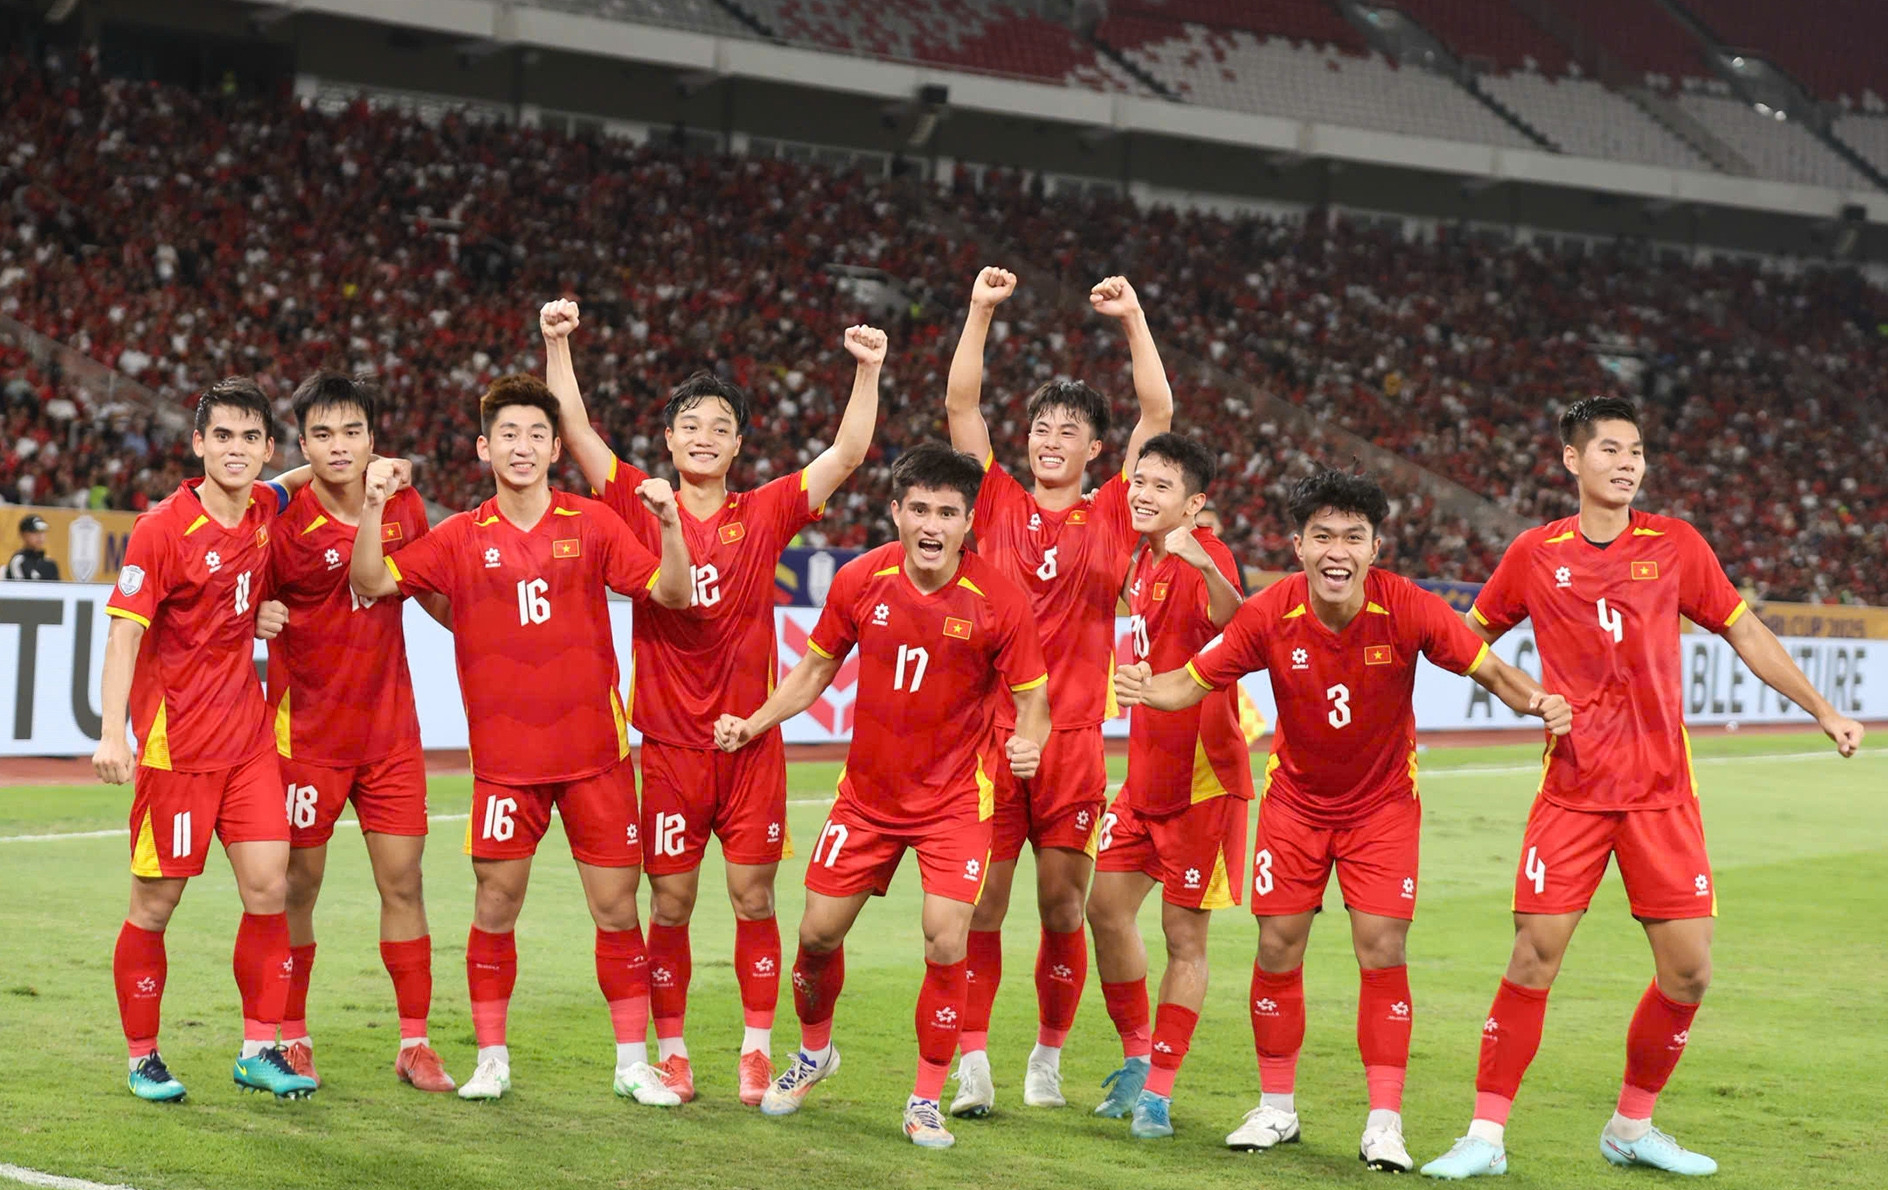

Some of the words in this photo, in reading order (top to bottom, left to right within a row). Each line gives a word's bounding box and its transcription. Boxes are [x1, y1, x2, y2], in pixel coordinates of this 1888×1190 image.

[235, 571, 252, 616] 11
[516, 578, 551, 626] 16
[690, 563, 721, 607] 12
[1597, 598, 1623, 644] 4
[894, 644, 929, 692] 17
[1326, 683, 1351, 729] 3
[286, 783, 318, 829] 18
[483, 795, 518, 842] 16
[173, 811, 192, 859] 11
[655, 812, 686, 857] 12
[814, 819, 849, 869] 17
[1255, 848, 1274, 896] 3
[1525, 846, 1546, 894] 4
